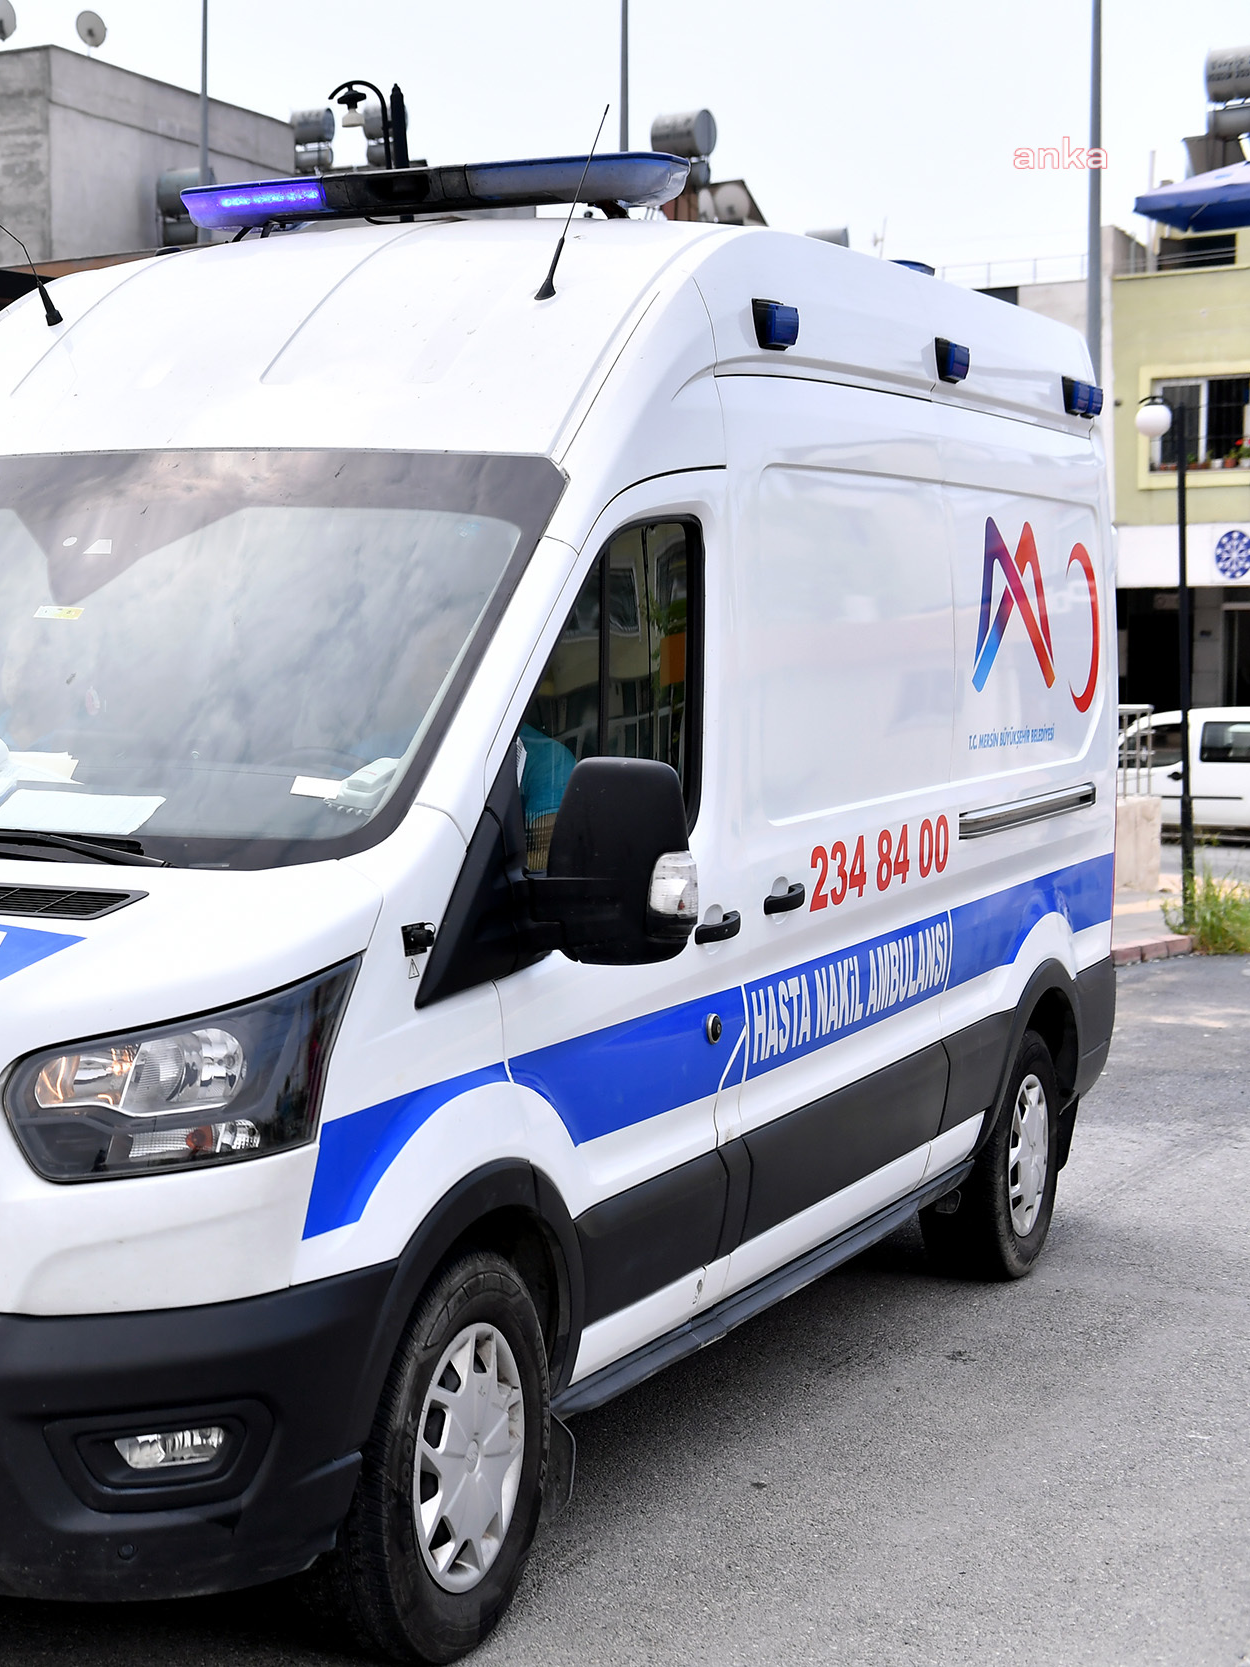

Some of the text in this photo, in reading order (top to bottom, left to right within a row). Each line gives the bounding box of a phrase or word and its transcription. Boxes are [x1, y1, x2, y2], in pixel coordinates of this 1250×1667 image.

[809, 814, 949, 912] 234 84 00
[751, 973, 812, 1065] HASTA
[866, 920, 949, 1019] AMBULANSI
